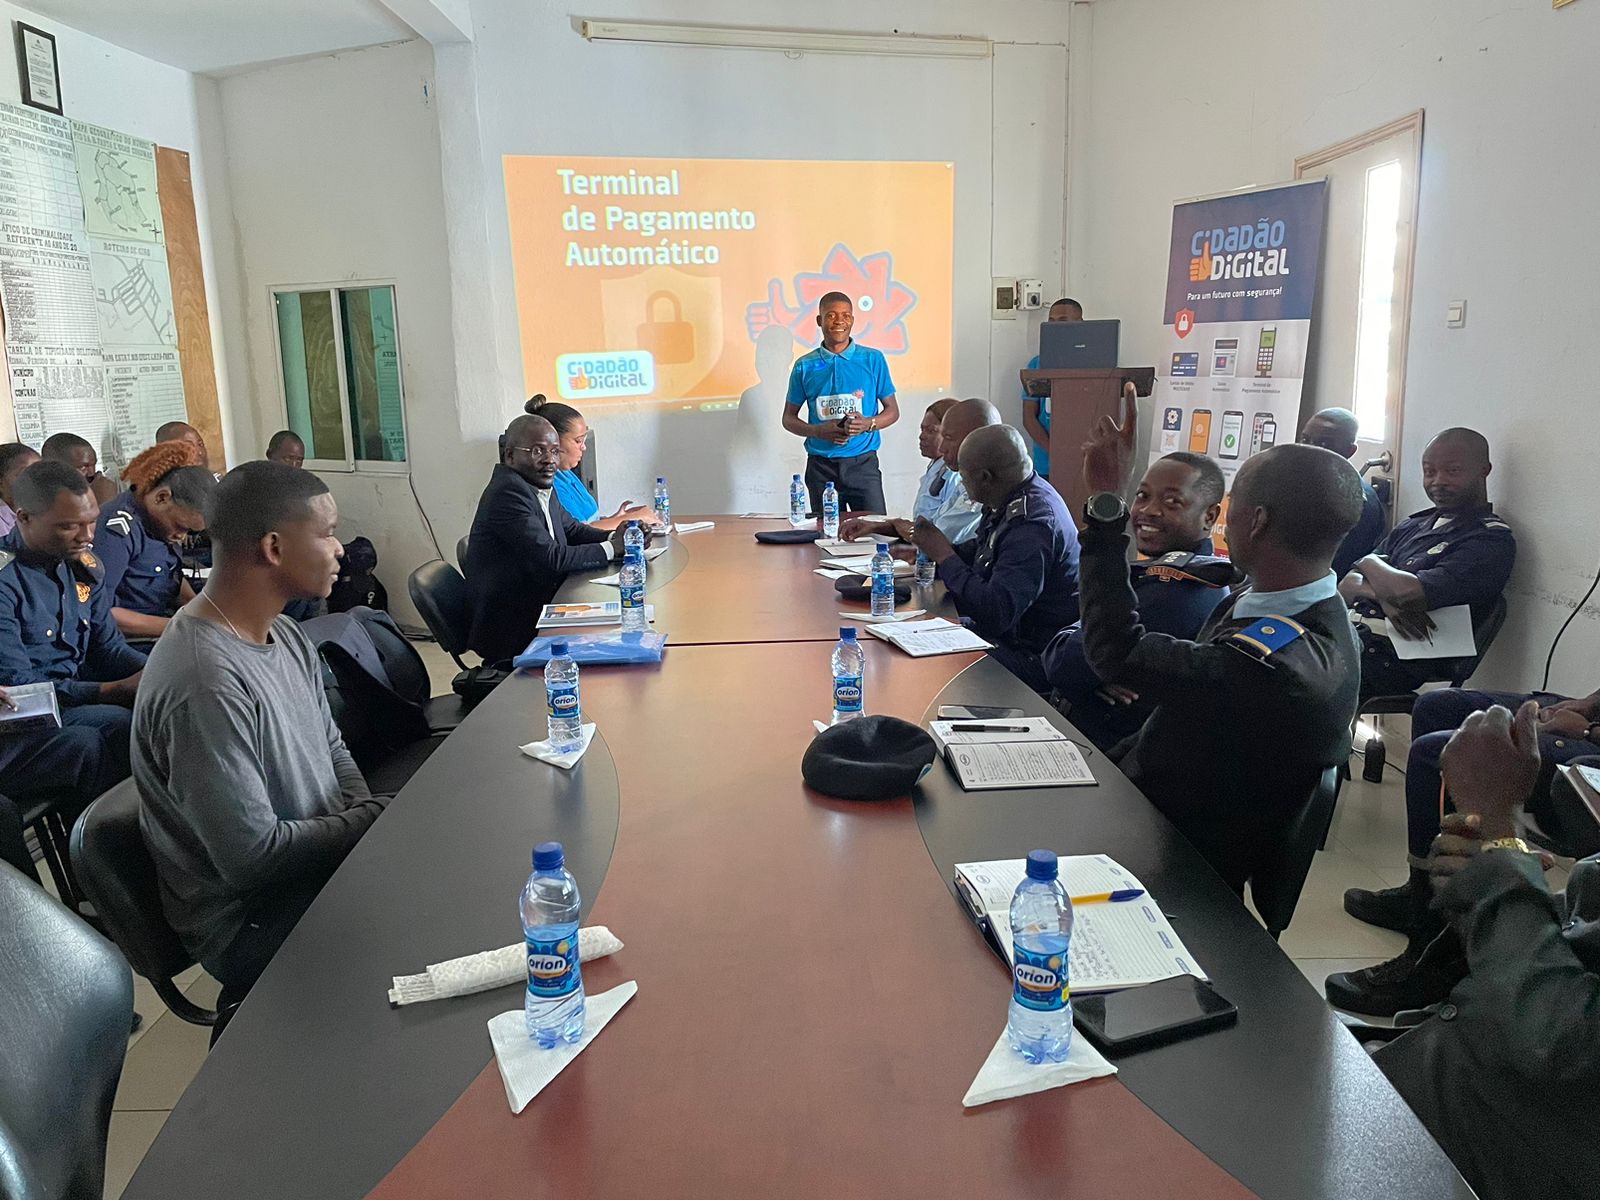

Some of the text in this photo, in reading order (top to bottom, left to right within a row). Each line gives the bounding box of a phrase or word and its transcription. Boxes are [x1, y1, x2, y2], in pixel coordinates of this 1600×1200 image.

[556, 169, 679, 196] Terminal
[562, 205, 756, 237] de Pagamento
[565, 238, 719, 267] Automático
[1187, 293, 1201, 301] Para
[1212, 290, 1231, 299] futuro
[1232, 290, 1245, 298] com
[1246, 286, 1283, 299] segurança!
[837, 687, 858, 697] orion
[554, 696, 575, 705] orion
[529, 957, 564, 970] orion
[1017, 967, 1054, 985] orion
